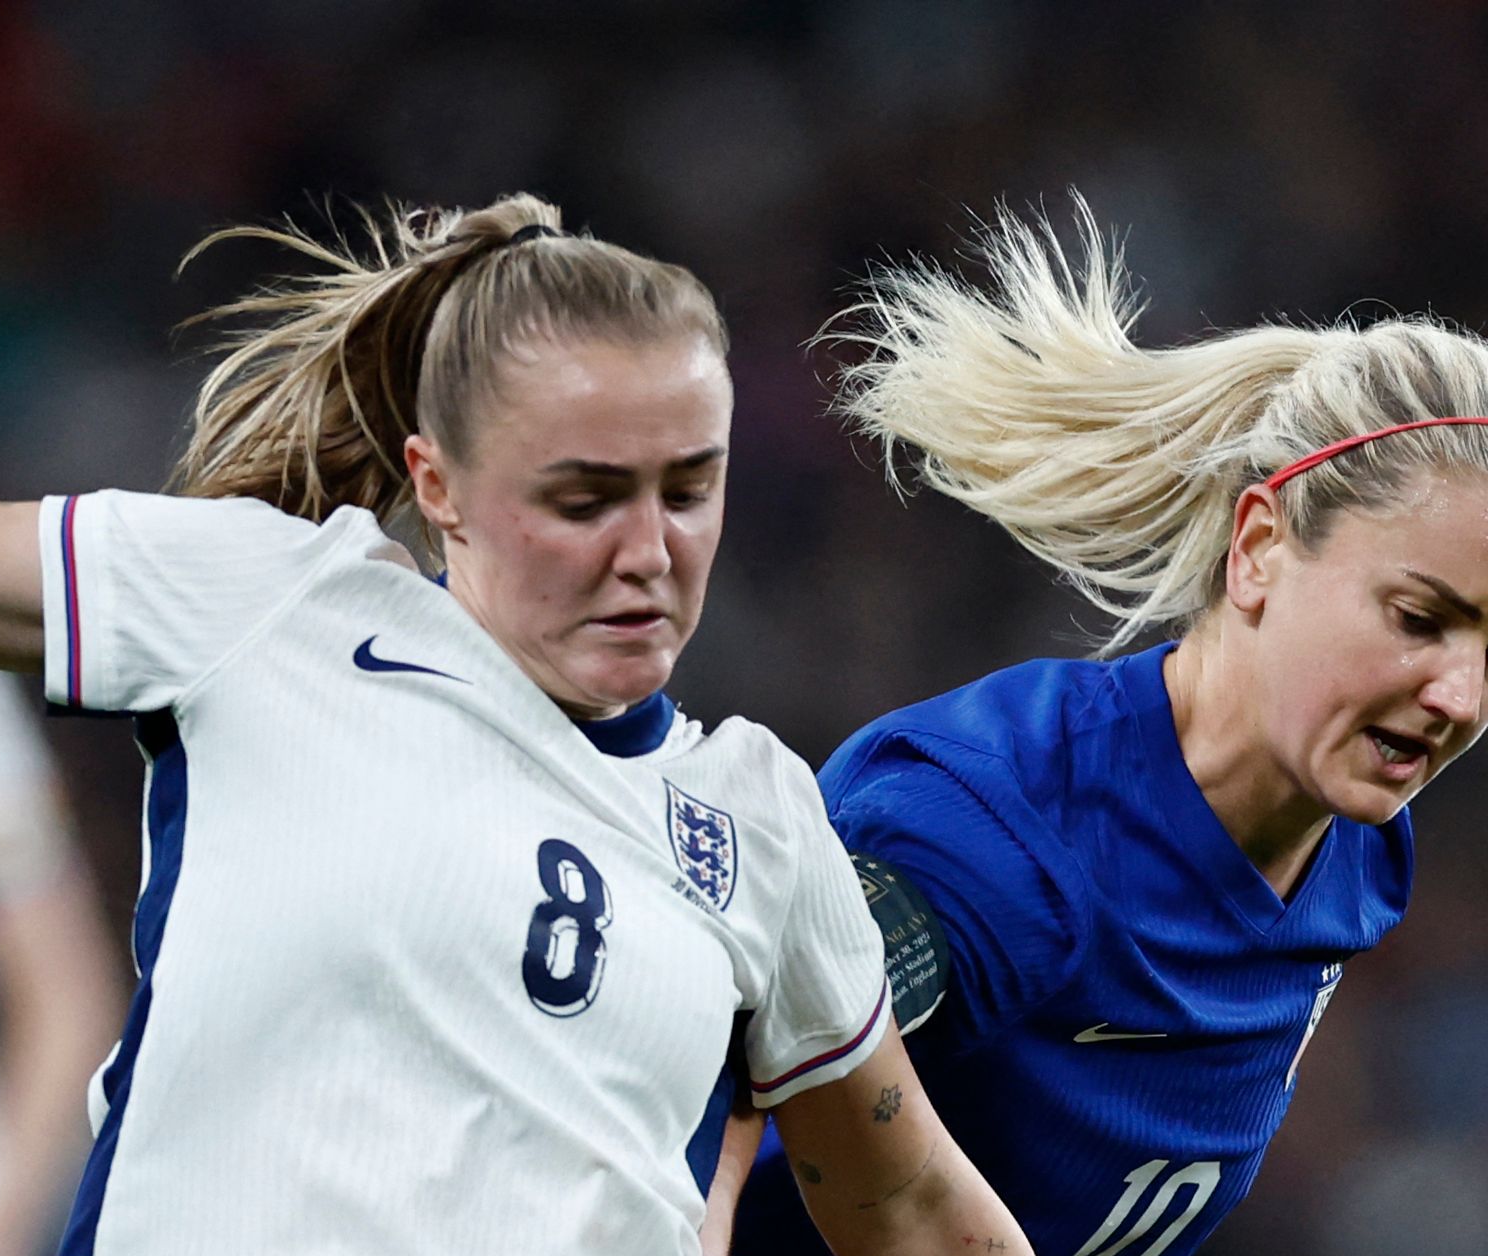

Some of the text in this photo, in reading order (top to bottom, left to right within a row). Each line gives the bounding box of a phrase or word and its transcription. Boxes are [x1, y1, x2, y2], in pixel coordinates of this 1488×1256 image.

[522, 838, 613, 1018] 8
[905, 948, 935, 971] Stadium
[909, 961, 938, 988] England
